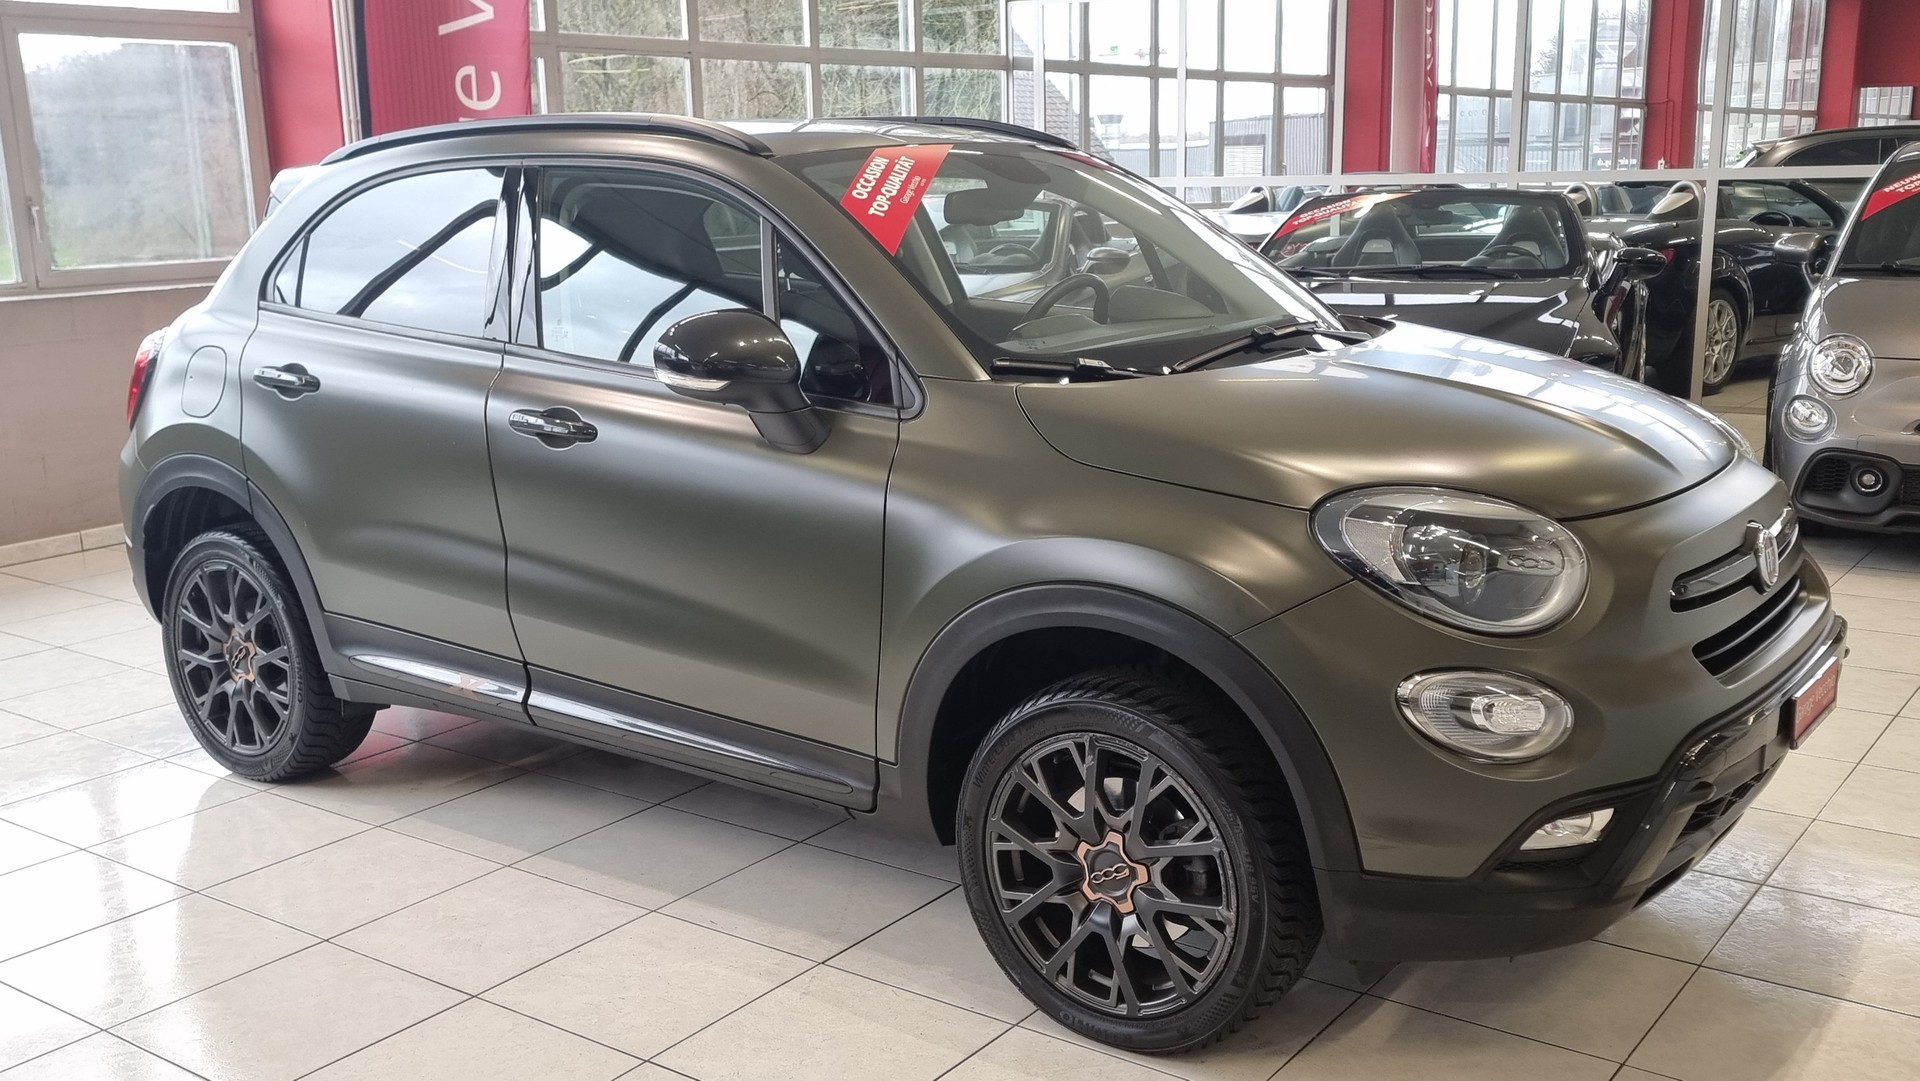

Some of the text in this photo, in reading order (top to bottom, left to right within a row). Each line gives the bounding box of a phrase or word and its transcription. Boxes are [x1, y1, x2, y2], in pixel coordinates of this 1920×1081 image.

[455, 65, 501, 121] e
[851, 156, 890, 200] OCCASION
[868, 155, 916, 217] TOP-QUALITÄT
[1299, 199, 1351, 219] OCCASION
[1507, 553, 1556, 570] 500
[1090, 863, 1130, 884] 500
